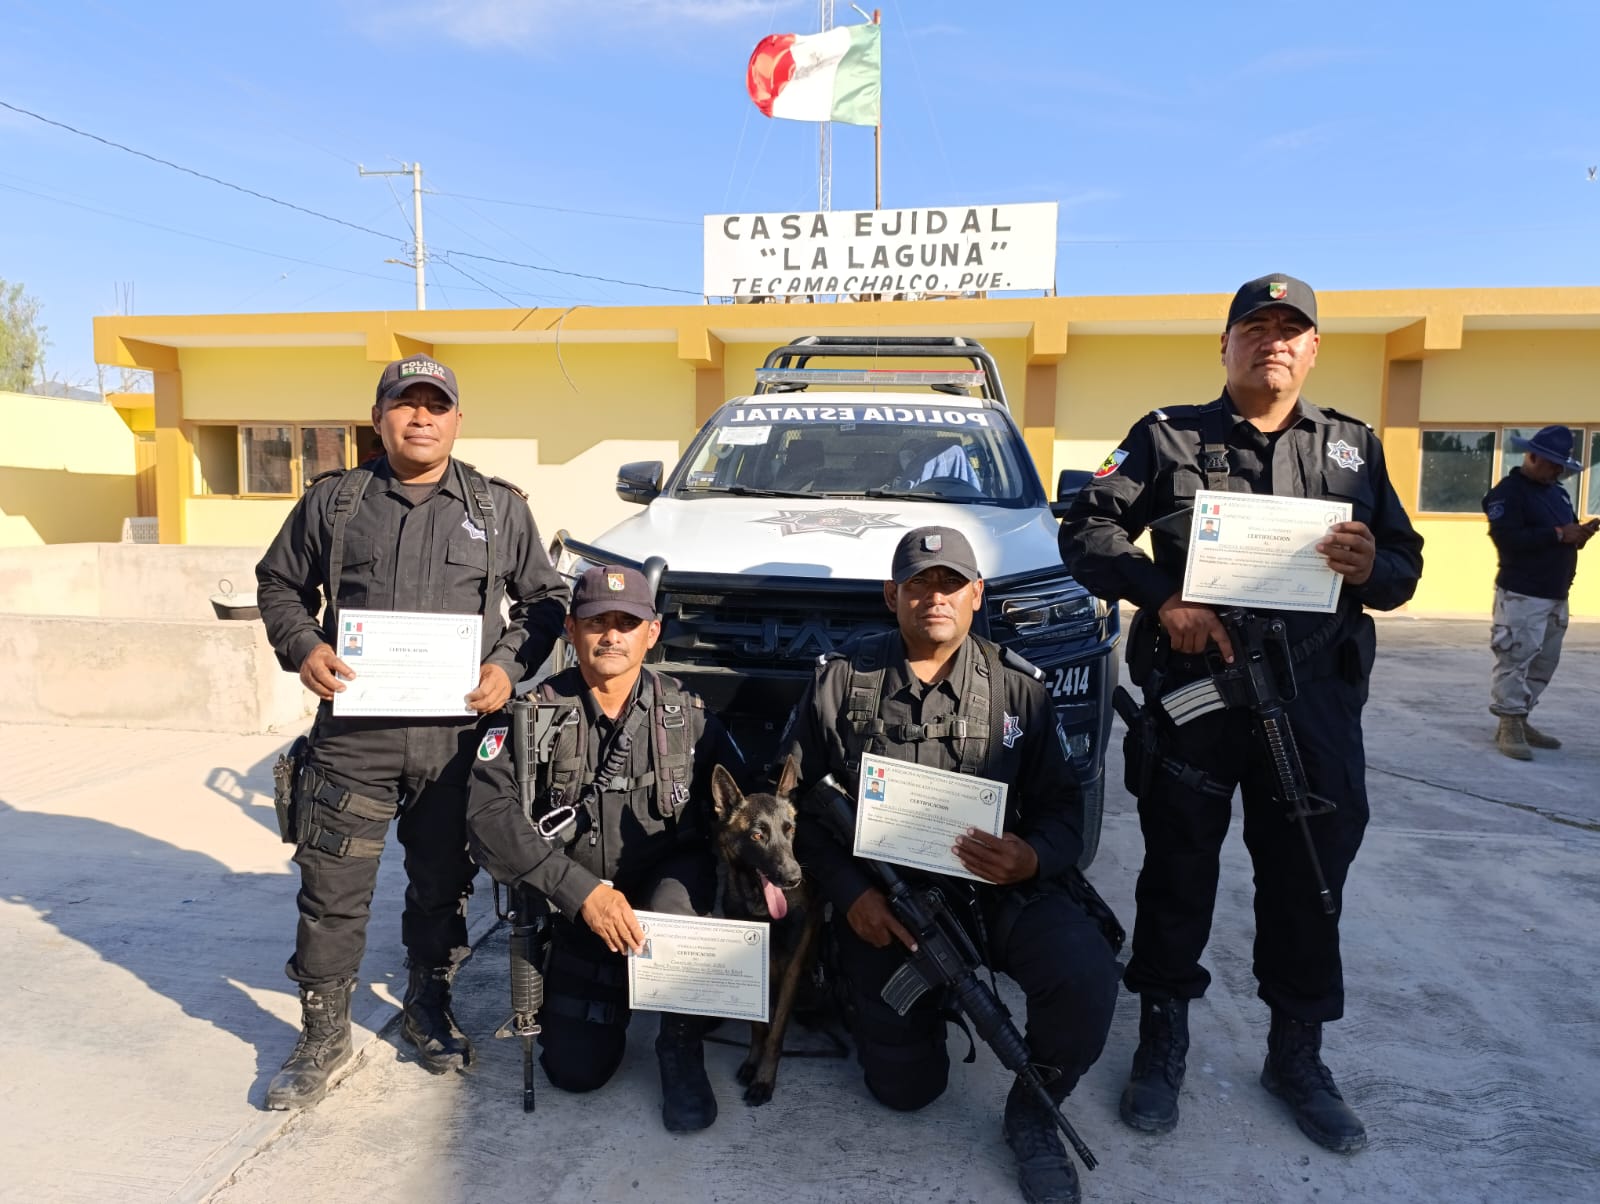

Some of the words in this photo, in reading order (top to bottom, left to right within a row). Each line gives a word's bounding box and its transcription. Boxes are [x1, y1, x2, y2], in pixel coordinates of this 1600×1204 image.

[723, 214, 829, 240] CASA
[854, 208, 1012, 237] EJIDAL
[957, 272, 1012, 290] PUE.
[401, 366, 445, 377] ESTATAL
